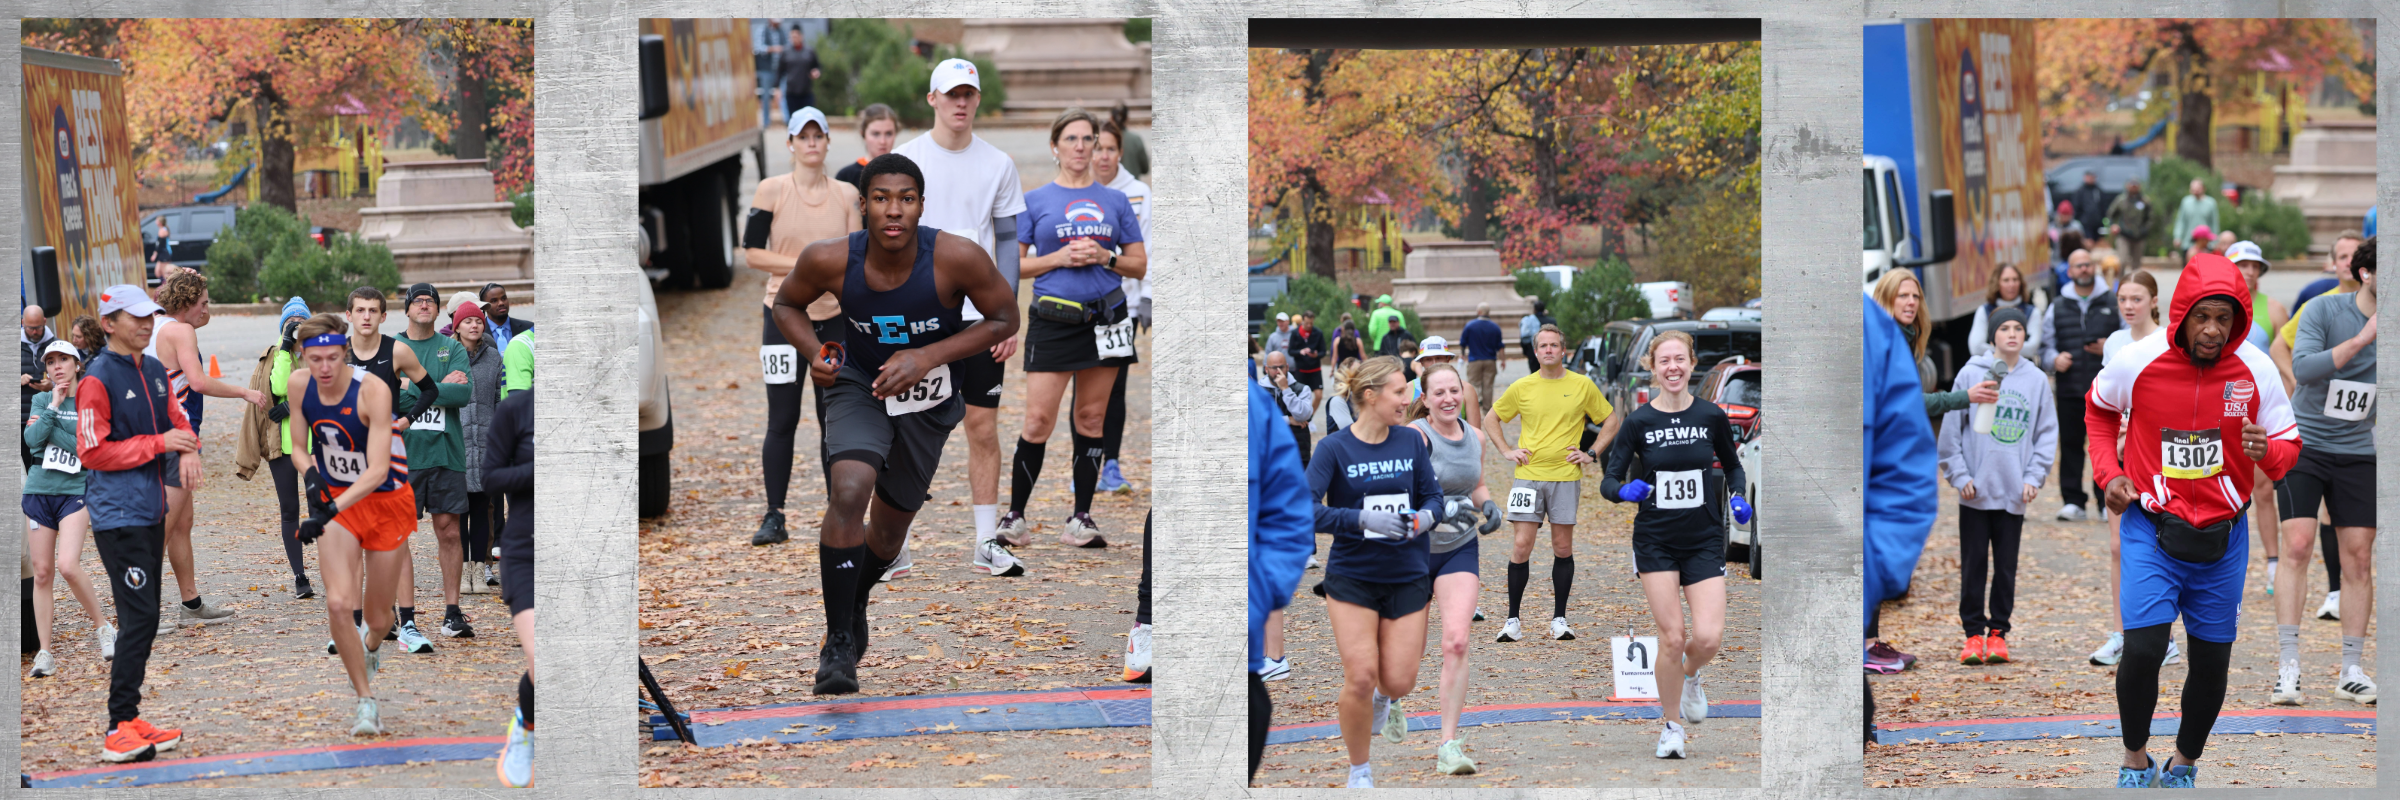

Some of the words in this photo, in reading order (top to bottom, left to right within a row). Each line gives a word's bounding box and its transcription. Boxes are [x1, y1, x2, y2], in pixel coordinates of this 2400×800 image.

[71, 89, 106, 165] BEST
[82, 166, 123, 243] THING
[1056, 226, 1076, 238] ST.
[1077, 225, 1113, 237] LOUIS
[1103, 325, 1132, 350] 318
[762, 354, 790, 375] 185
[2224, 402, 2249, 412] USA
[2334, 389, 2369, 412] 184
[1994, 405, 2030, 423] TATE
[1645, 426, 1708, 444] SPEWAK
[49, 447, 76, 467] 366
[329, 455, 361, 475] 434
[2167, 444, 2219, 468] 1302
[1347, 458, 1413, 478] SPEWAK
[1372, 472, 1395, 481] RACING
[1510, 493, 1532, 507] 285
[1664, 479, 1697, 501] 139
